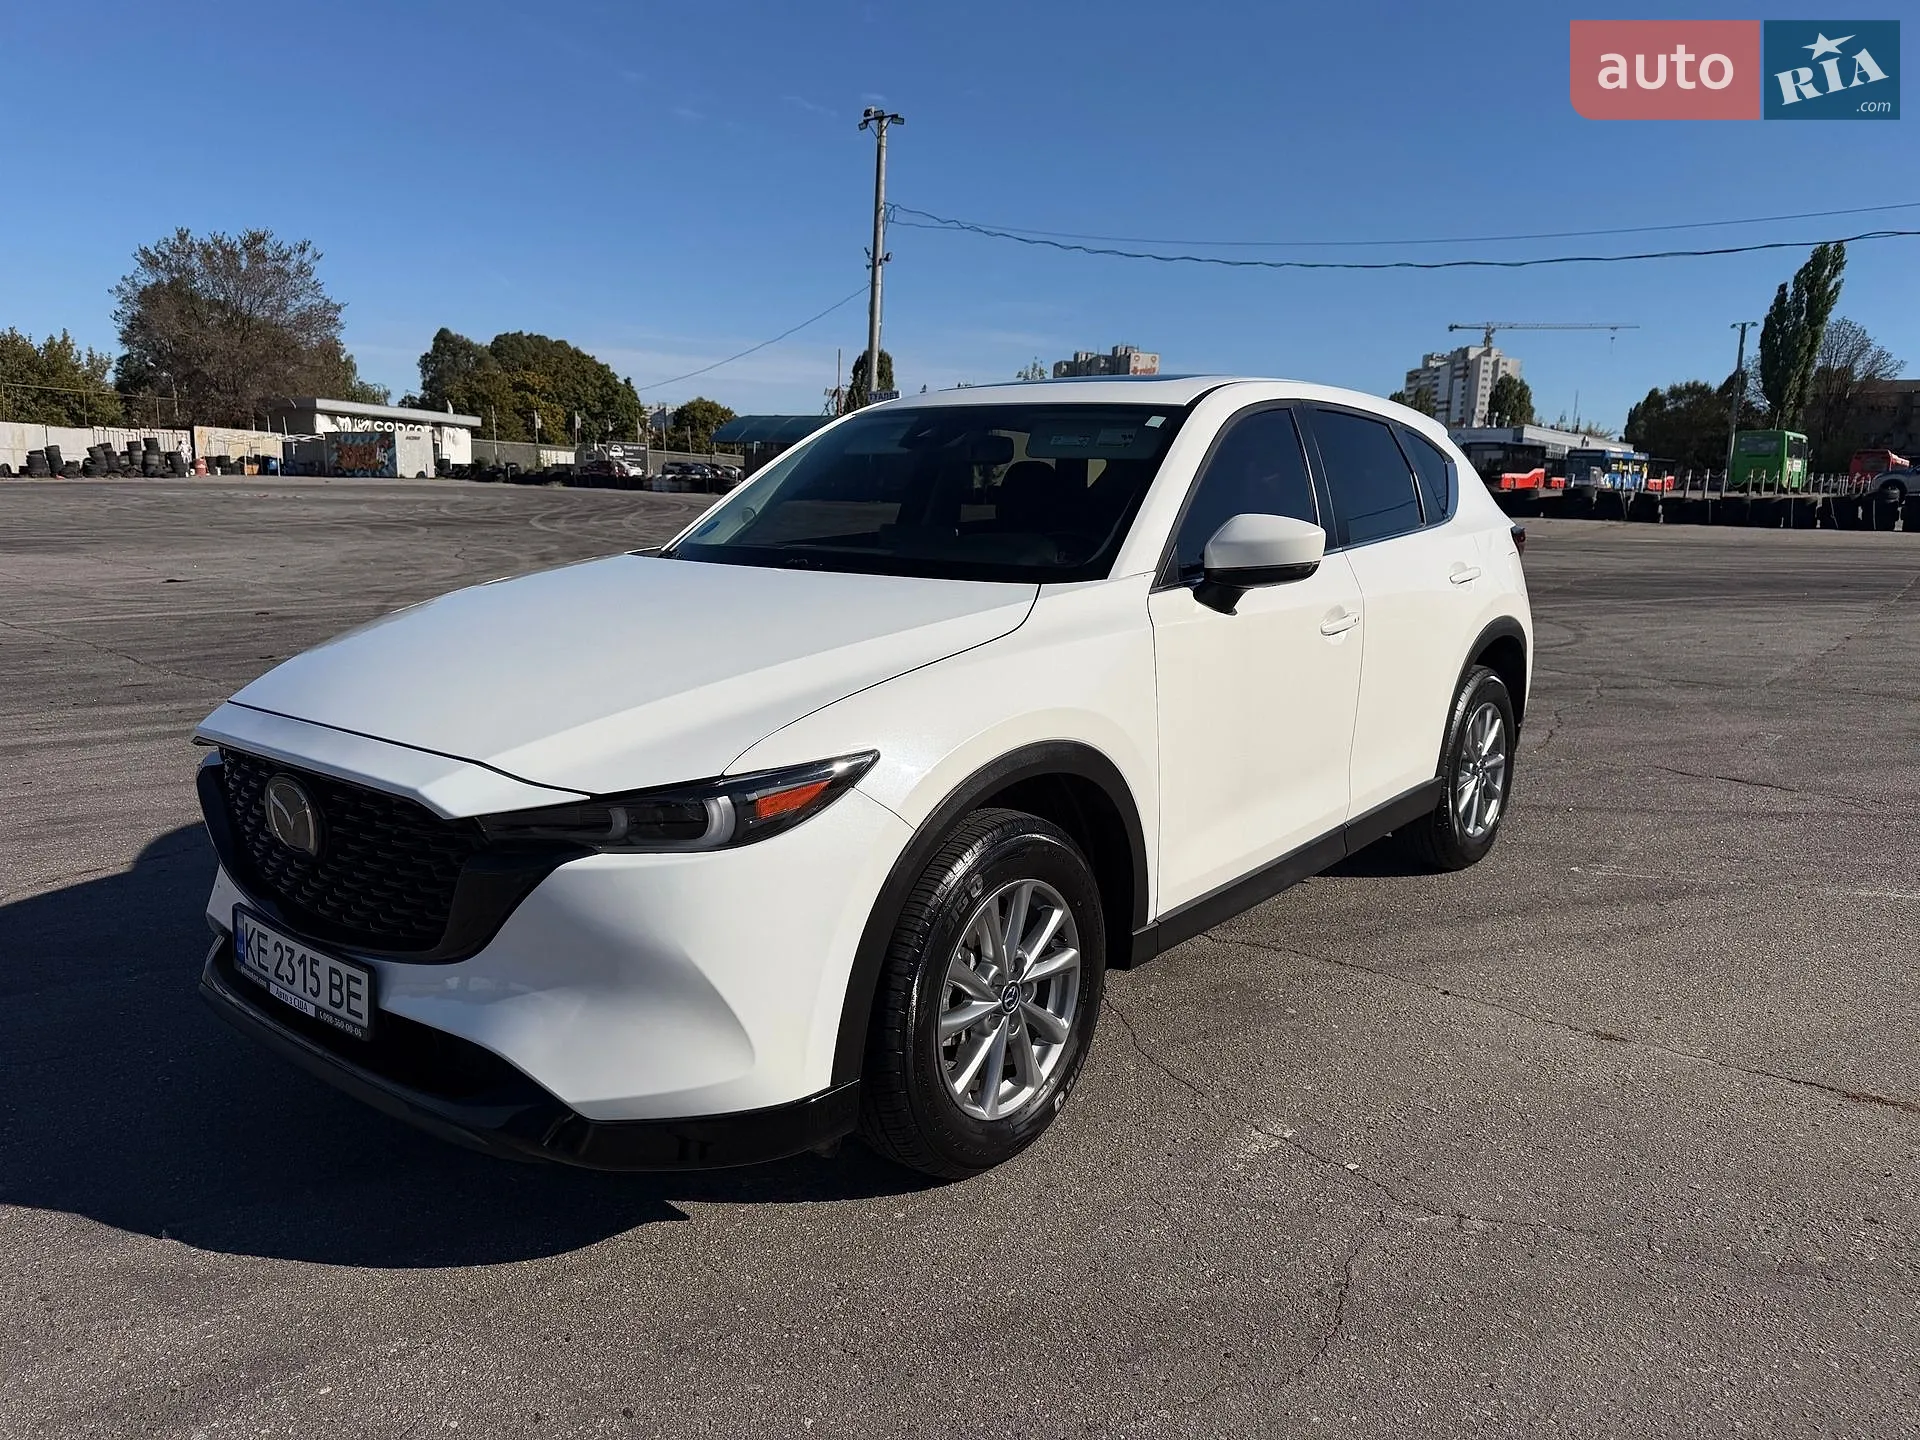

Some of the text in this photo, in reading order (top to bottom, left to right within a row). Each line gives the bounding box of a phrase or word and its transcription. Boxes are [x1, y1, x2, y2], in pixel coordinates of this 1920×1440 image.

[245, 922, 269, 973] KE
[273, 941, 321, 998] 2315
[328, 966, 363, 1020] BE
